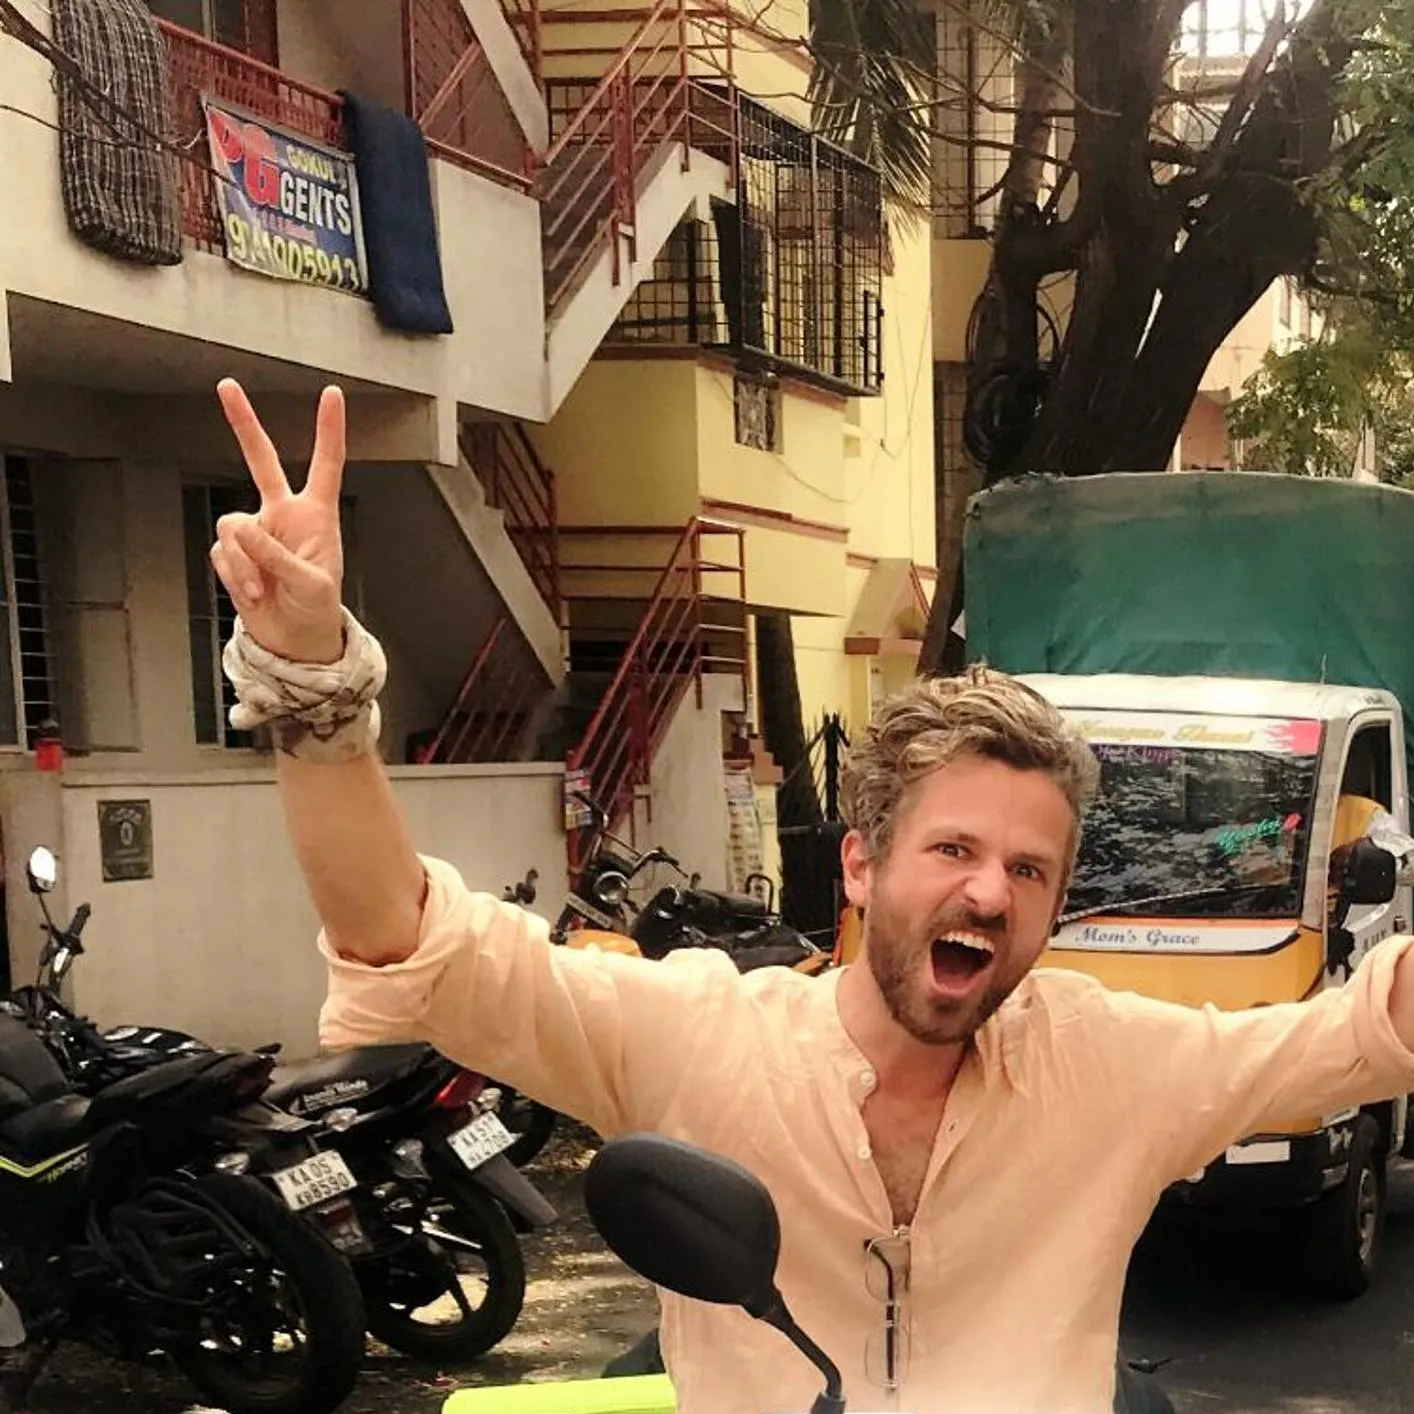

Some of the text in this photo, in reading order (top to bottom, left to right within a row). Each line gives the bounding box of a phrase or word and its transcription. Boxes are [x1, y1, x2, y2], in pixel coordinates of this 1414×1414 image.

[280, 170, 352, 236] GENTS
[1075, 926, 1200, 946] Mom's Grace
[286, 1167, 312, 1187] KA
